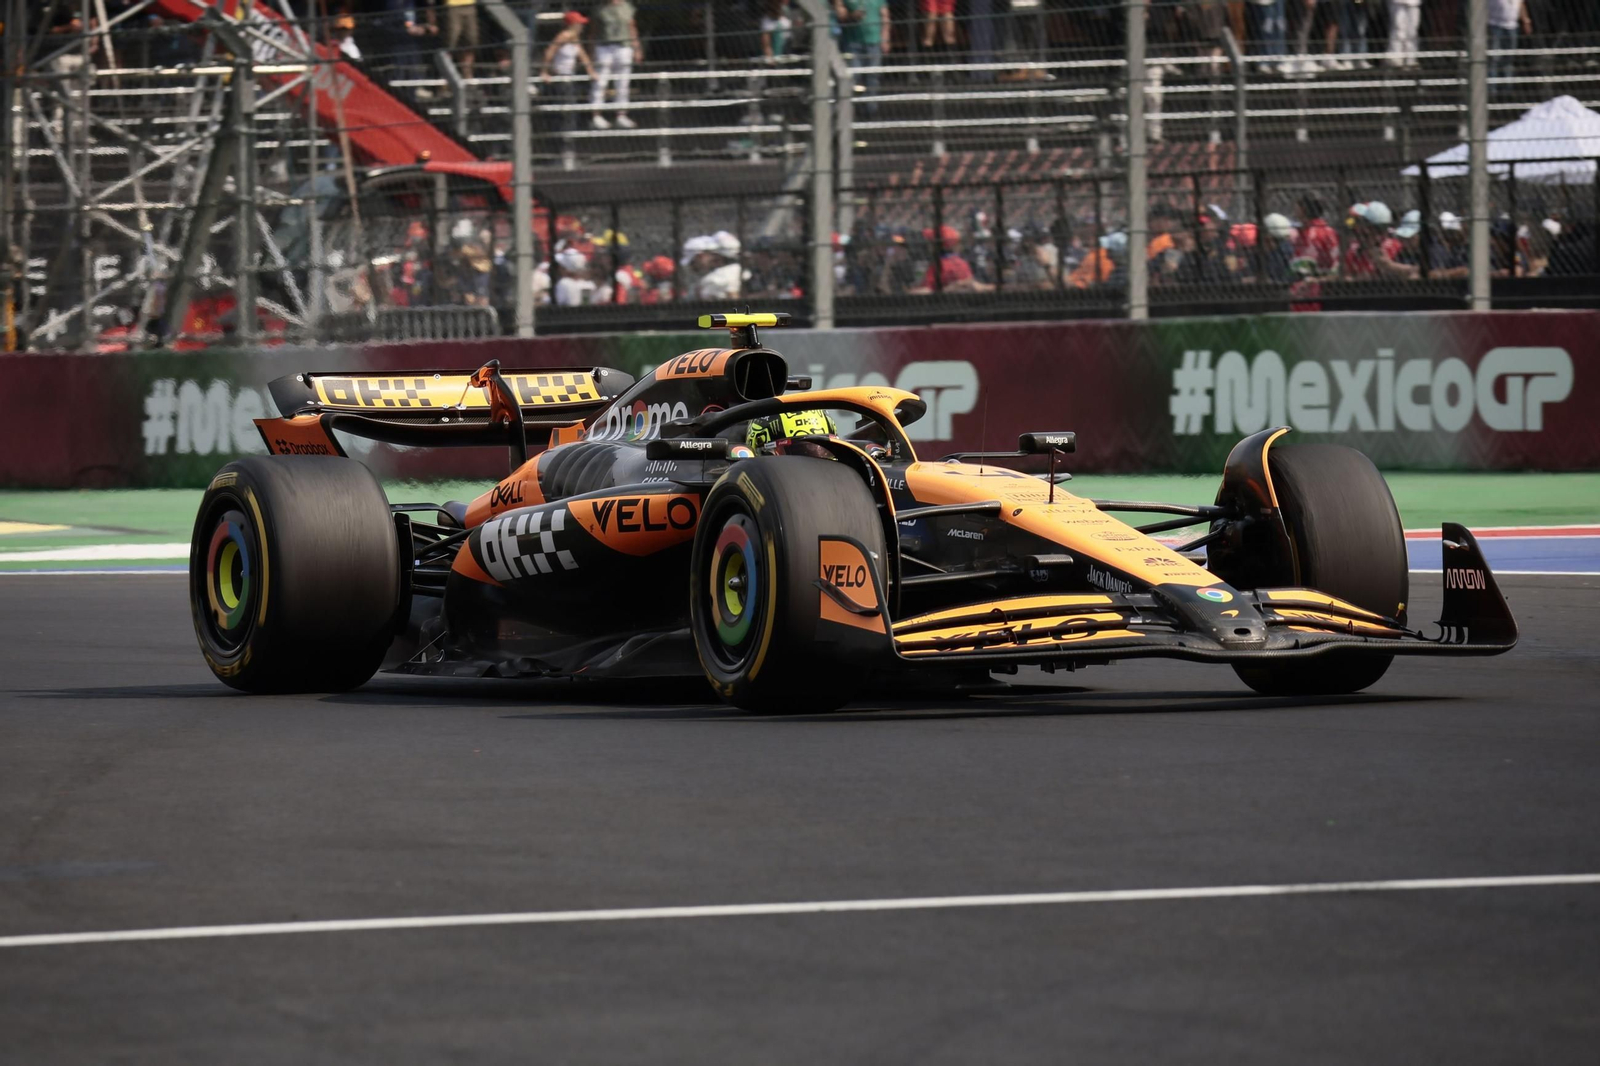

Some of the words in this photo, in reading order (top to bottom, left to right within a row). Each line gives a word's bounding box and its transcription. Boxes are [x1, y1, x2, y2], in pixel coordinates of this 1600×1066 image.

[666, 350, 721, 376] VELO
[1170, 347, 1574, 434] #MexicoGP
[289, 442, 332, 455] Dropbox
[679, 440, 712, 450] Allegra
[490, 480, 524, 507] DELL
[592, 496, 697, 534] VELO
[947, 528, 984, 541] McLaren
[822, 564, 867, 588] VELO
[1086, 564, 1105, 590] JACK
